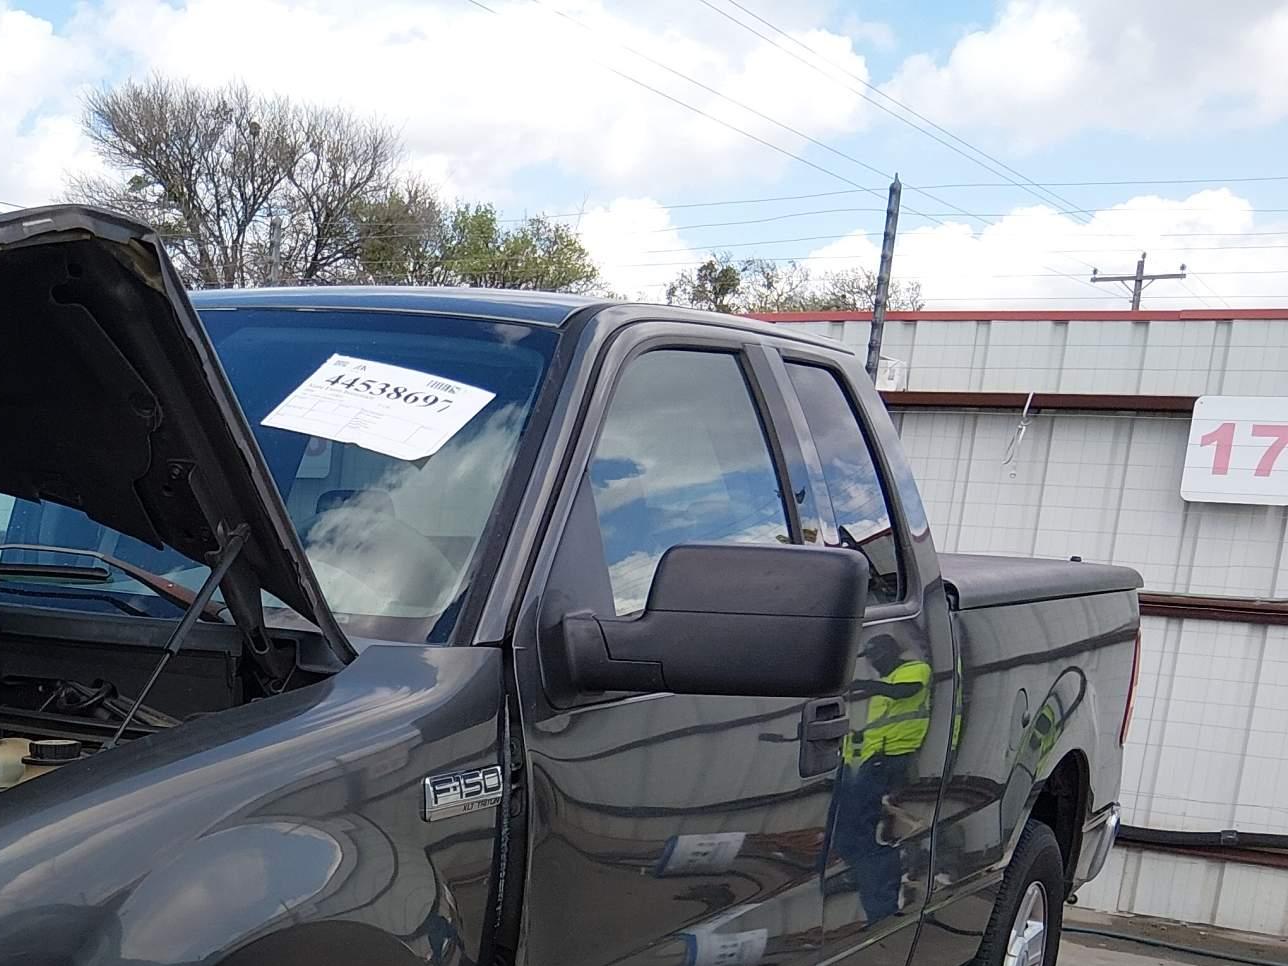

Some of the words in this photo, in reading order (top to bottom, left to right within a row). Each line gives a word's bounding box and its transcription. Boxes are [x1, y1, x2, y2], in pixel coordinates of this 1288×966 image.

[325, 374, 453, 413] 44538697
[1200, 422, 1288, 477] 17
[431, 767, 501, 804] F-150
